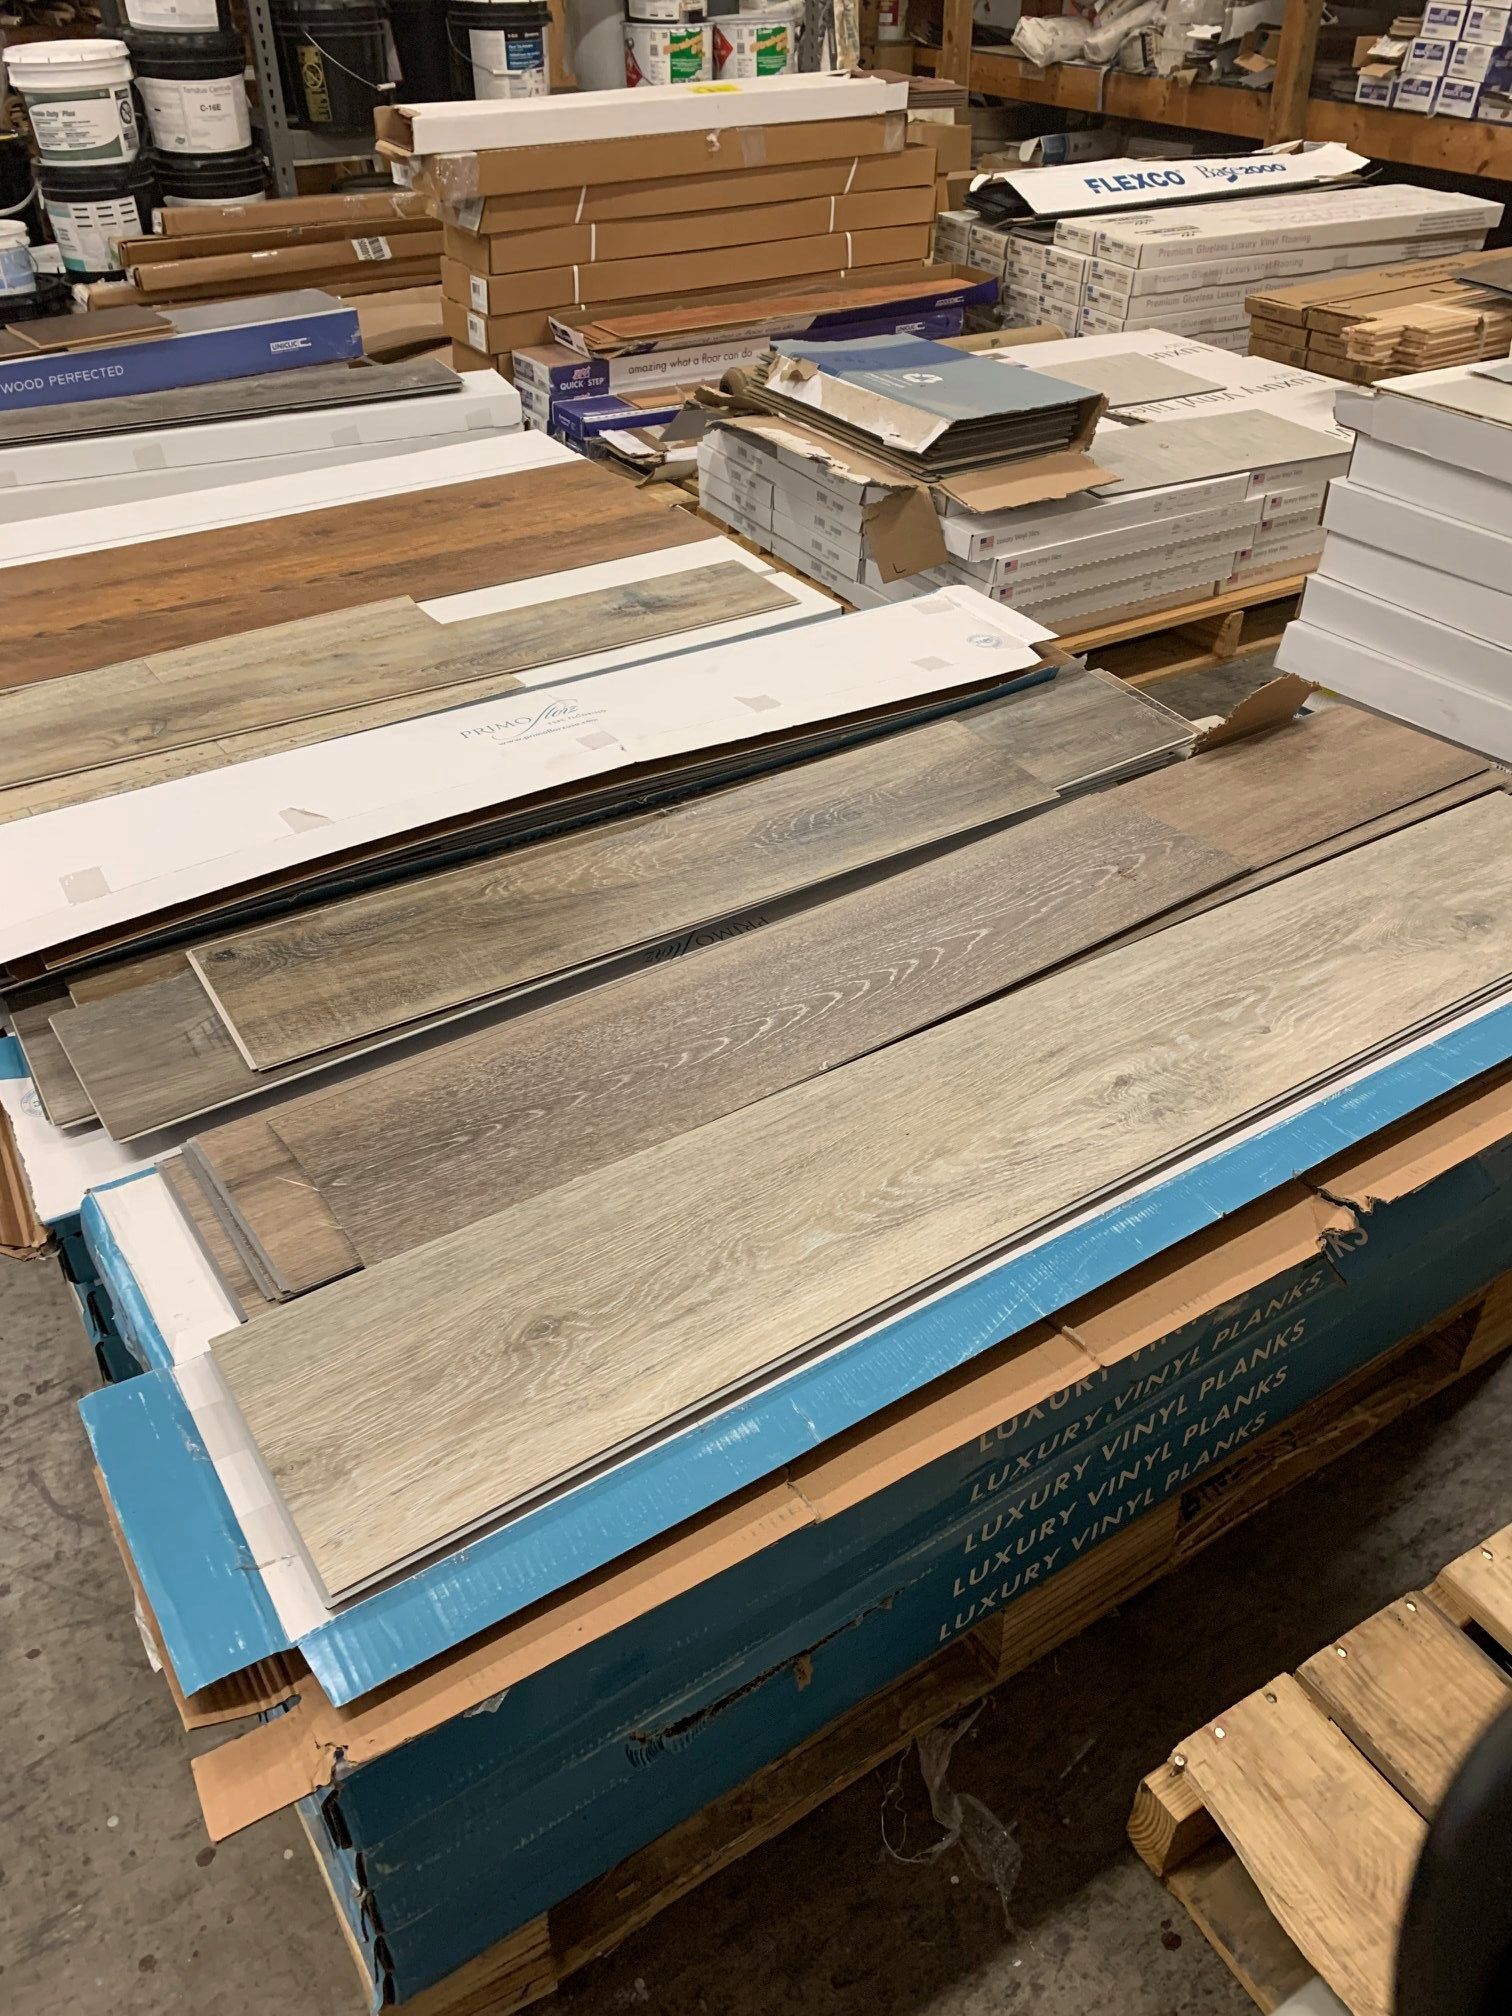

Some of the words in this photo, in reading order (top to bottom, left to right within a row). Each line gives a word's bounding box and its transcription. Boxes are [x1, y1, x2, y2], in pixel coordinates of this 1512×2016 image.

[1084, 170, 1186, 194] FLEXCO
[1158, 247, 1193, 258] Premium
[1231, 240, 1257, 251] Luxury
[1260, 237, 1278, 247] Vinyl
[1281, 233, 1312, 245] Flooring
[1154, 272, 1188, 283] Premium
[1225, 265, 1250, 275] Luxury
[1146, 297, 1180, 308] Premium
[1217, 289, 1241, 299] Luxury
[271, 340, 298, 351] UNICLIC
[1147, 346, 1214, 360] Luxur
[628, 361, 667, 375] amazing
[669, 356, 691, 368] what
[701, 353, 721, 364] floor
[723, 352, 739, 361] can
[741, 347, 752, 358] do
[0, 378, 44, 394] WOOD
[48, 365, 124, 387] PERFECTED
[560, 379, 584, 391] QUICK
[588, 377, 604, 387] STEP
[1240, 375, 1327, 395] Luxury
[1178, 391, 1240, 408] Vinyl
[970, 1407, 1103, 1503] LUXURY
[1114, 1345, 1201, 1411] VINYL
[1212, 1270, 1323, 1351] PLANKS
[964, 1455, 1091, 1554] LUXURY
[1102, 1394, 1188, 1462] VINYL
[1199, 1318, 1306, 1401] PLANKS
[953, 1502, 1078, 1598] LUXURY
[1088, 1441, 1173, 1506] VINYL
[1183, 1365, 1289, 1447] PLANKS
[939, 1546, 1062, 1642] LUXURY
[1071, 1488, 1154, 1551] VINYL
[1164, 1411, 1267, 1492] PLANKS
